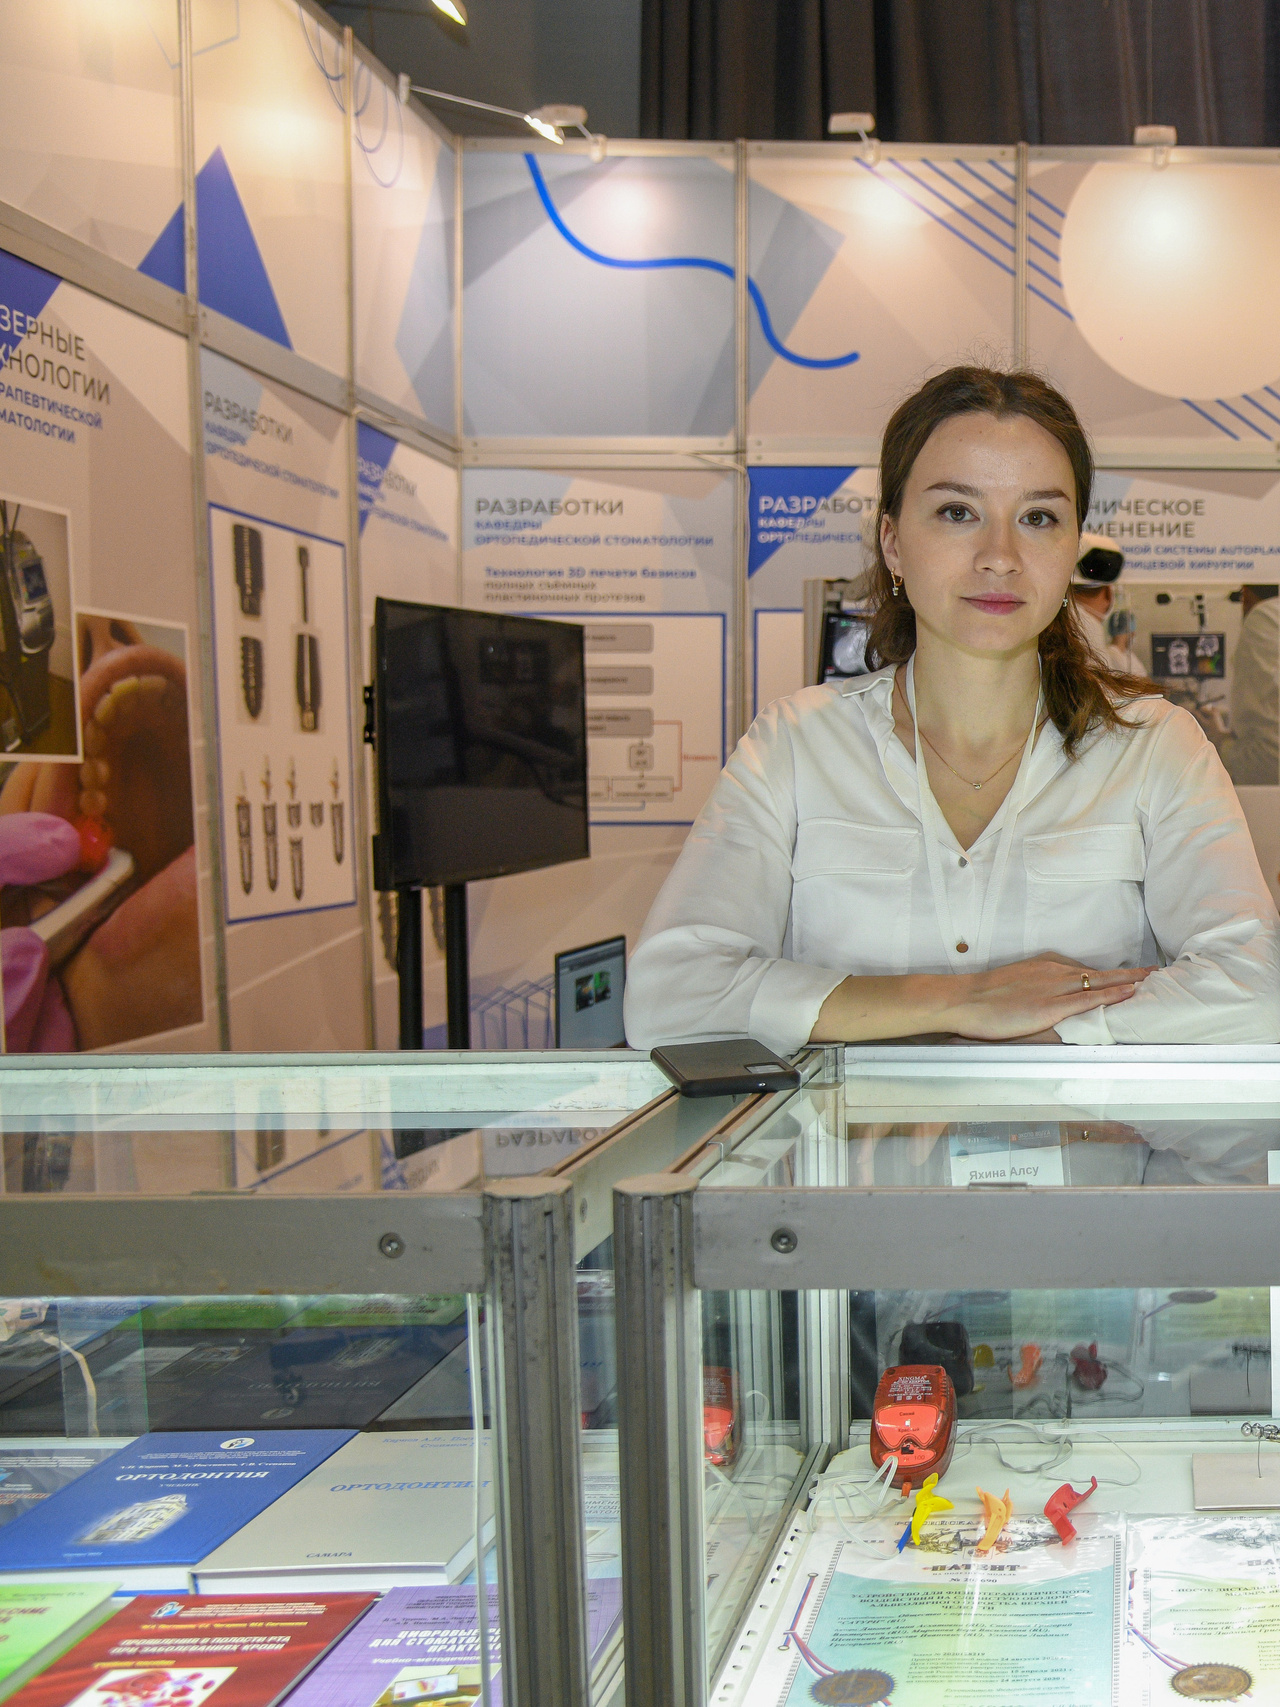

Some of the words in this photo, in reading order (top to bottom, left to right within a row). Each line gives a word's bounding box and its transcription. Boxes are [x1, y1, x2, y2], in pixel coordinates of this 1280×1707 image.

[205, 391, 293, 444] РАЗРАБОТКИ
[475, 498, 624, 516] РАЗРАБОТКИ
[474, 519, 543, 531] КАФЕДРЫ
[758, 517, 825, 529] КАФЕДРЫ
[474, 534, 601, 547] ОРТОПЕДИЧЕСКОЙ
[604, 535, 714, 547] СТОМАТОЛОГИИ
[969, 1169, 1006, 1181] Яхина
[1010, 1165, 1039, 1177] Алсу
[115, 1471, 270, 1481] ОРТОДОНТИЯ
[931, 1563, 1020, 1572] ПАТЕНТ
[368, 1638, 403, 1648] ДЛЯ
